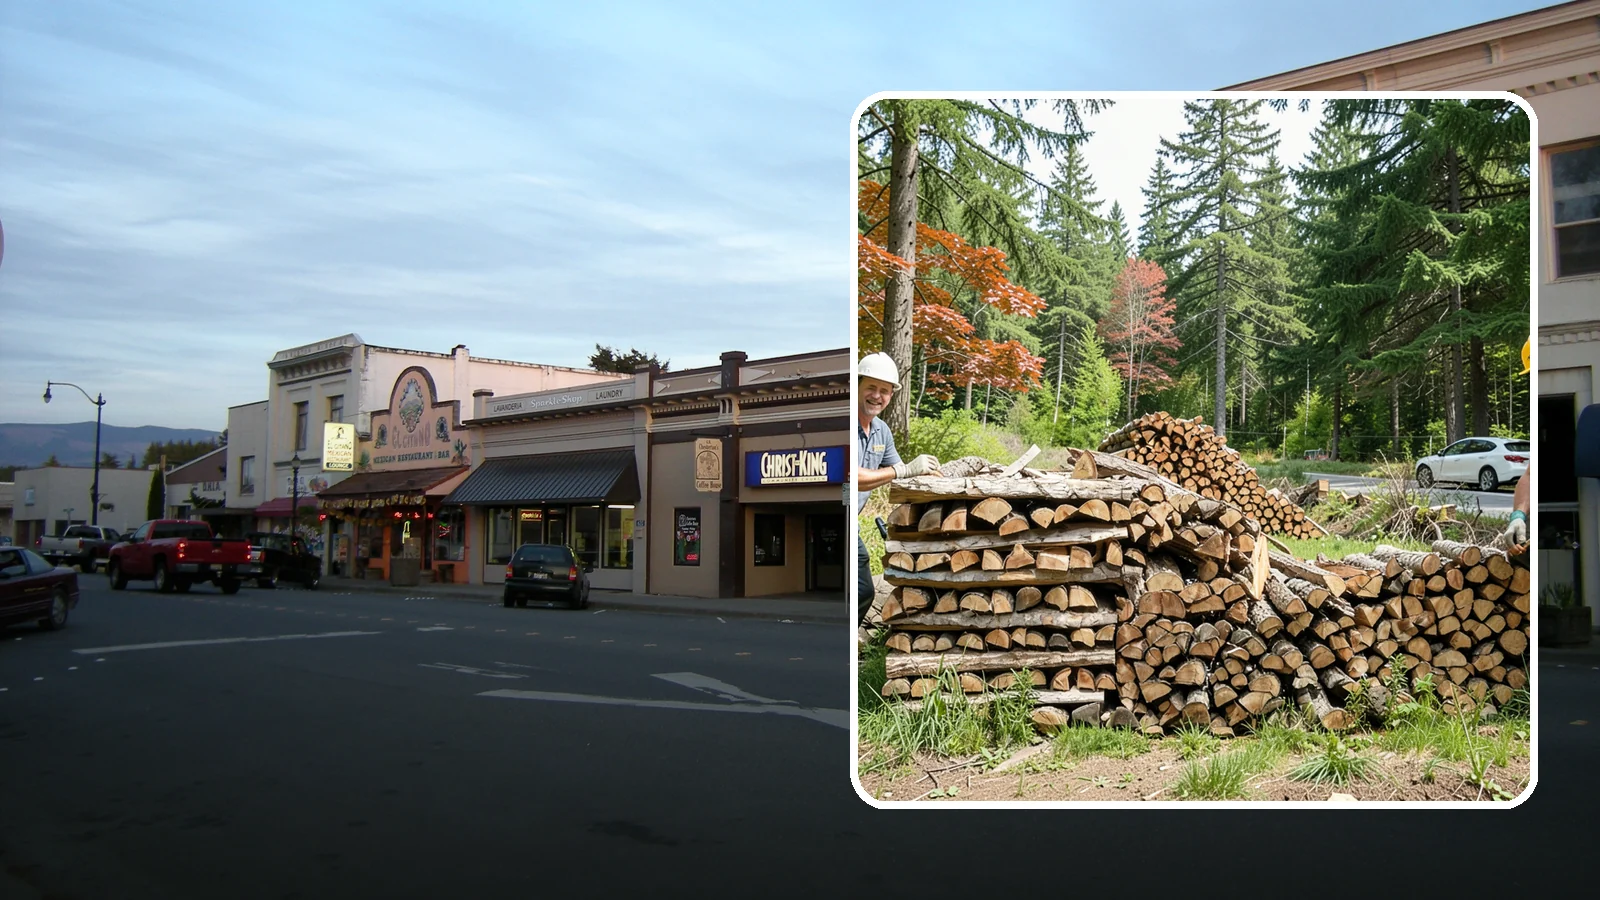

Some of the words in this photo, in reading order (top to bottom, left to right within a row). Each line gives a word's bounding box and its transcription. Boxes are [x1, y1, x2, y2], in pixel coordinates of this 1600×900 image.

[493, 402, 522, 413] LAVANDERIA
[561, 394, 582, 405] Shop
[595, 389, 623, 400] LAUNDRY
[398, 451, 434, 462] RESTAURANT
[438, 450, 450, 459] BAR
[760, 452, 797, 478] CHRIST
[799, 450, 827, 476] KING
